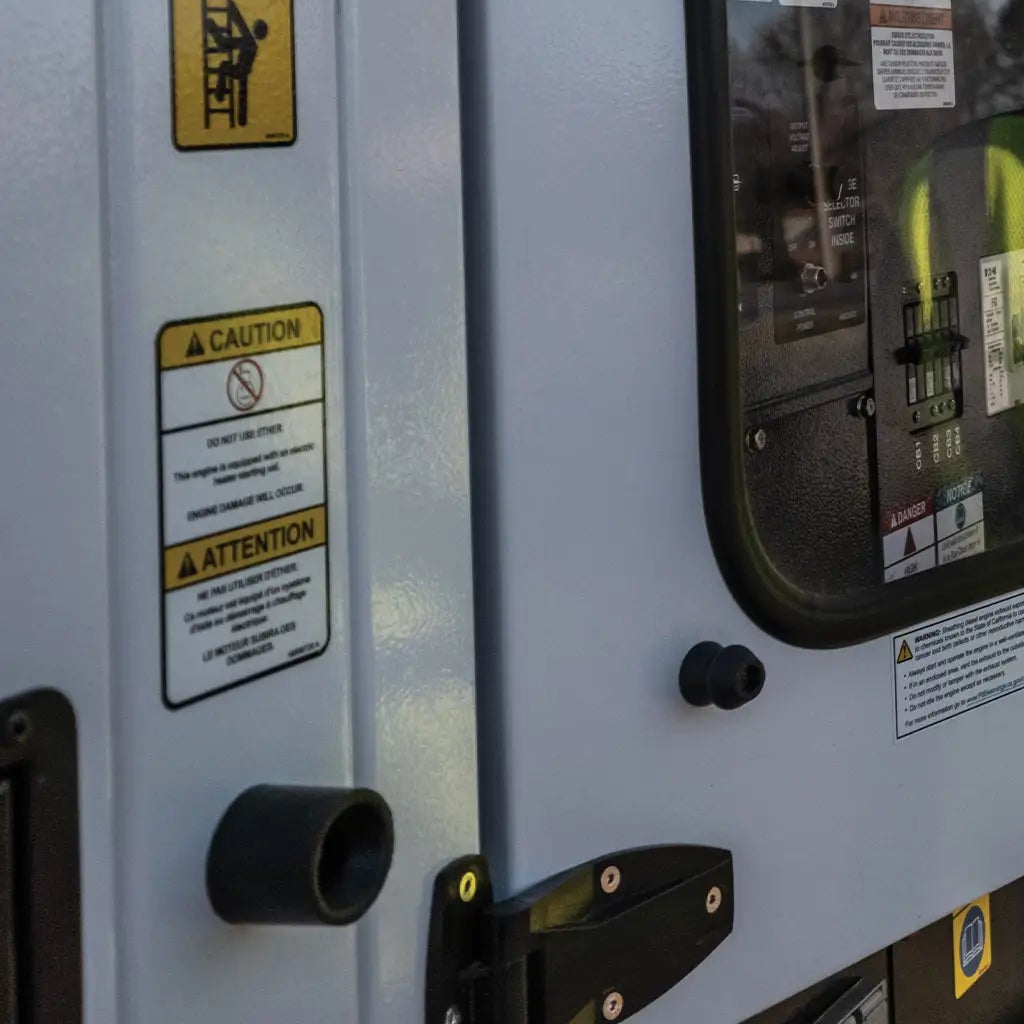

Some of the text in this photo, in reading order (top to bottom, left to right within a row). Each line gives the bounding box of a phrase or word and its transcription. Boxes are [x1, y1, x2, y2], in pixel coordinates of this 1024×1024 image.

[824, 195, 860, 212] SELECTOR
[828, 214, 856, 230] SWITCH
[831, 232, 855, 247] INSIDE
[210, 318, 302, 352] CAUTION
[206, 436, 219, 448] DO
[221, 432, 236, 445] NOT
[240, 428, 255, 441] USE
[946, 480, 972, 503] NOTICE
[187, 503, 216, 522] ENGINE
[220, 494, 253, 513] DAMAGE
[255, 489, 272, 504] WILL
[897, 501, 926, 525] DANGER
[201, 516, 314, 571] ATTENTION
